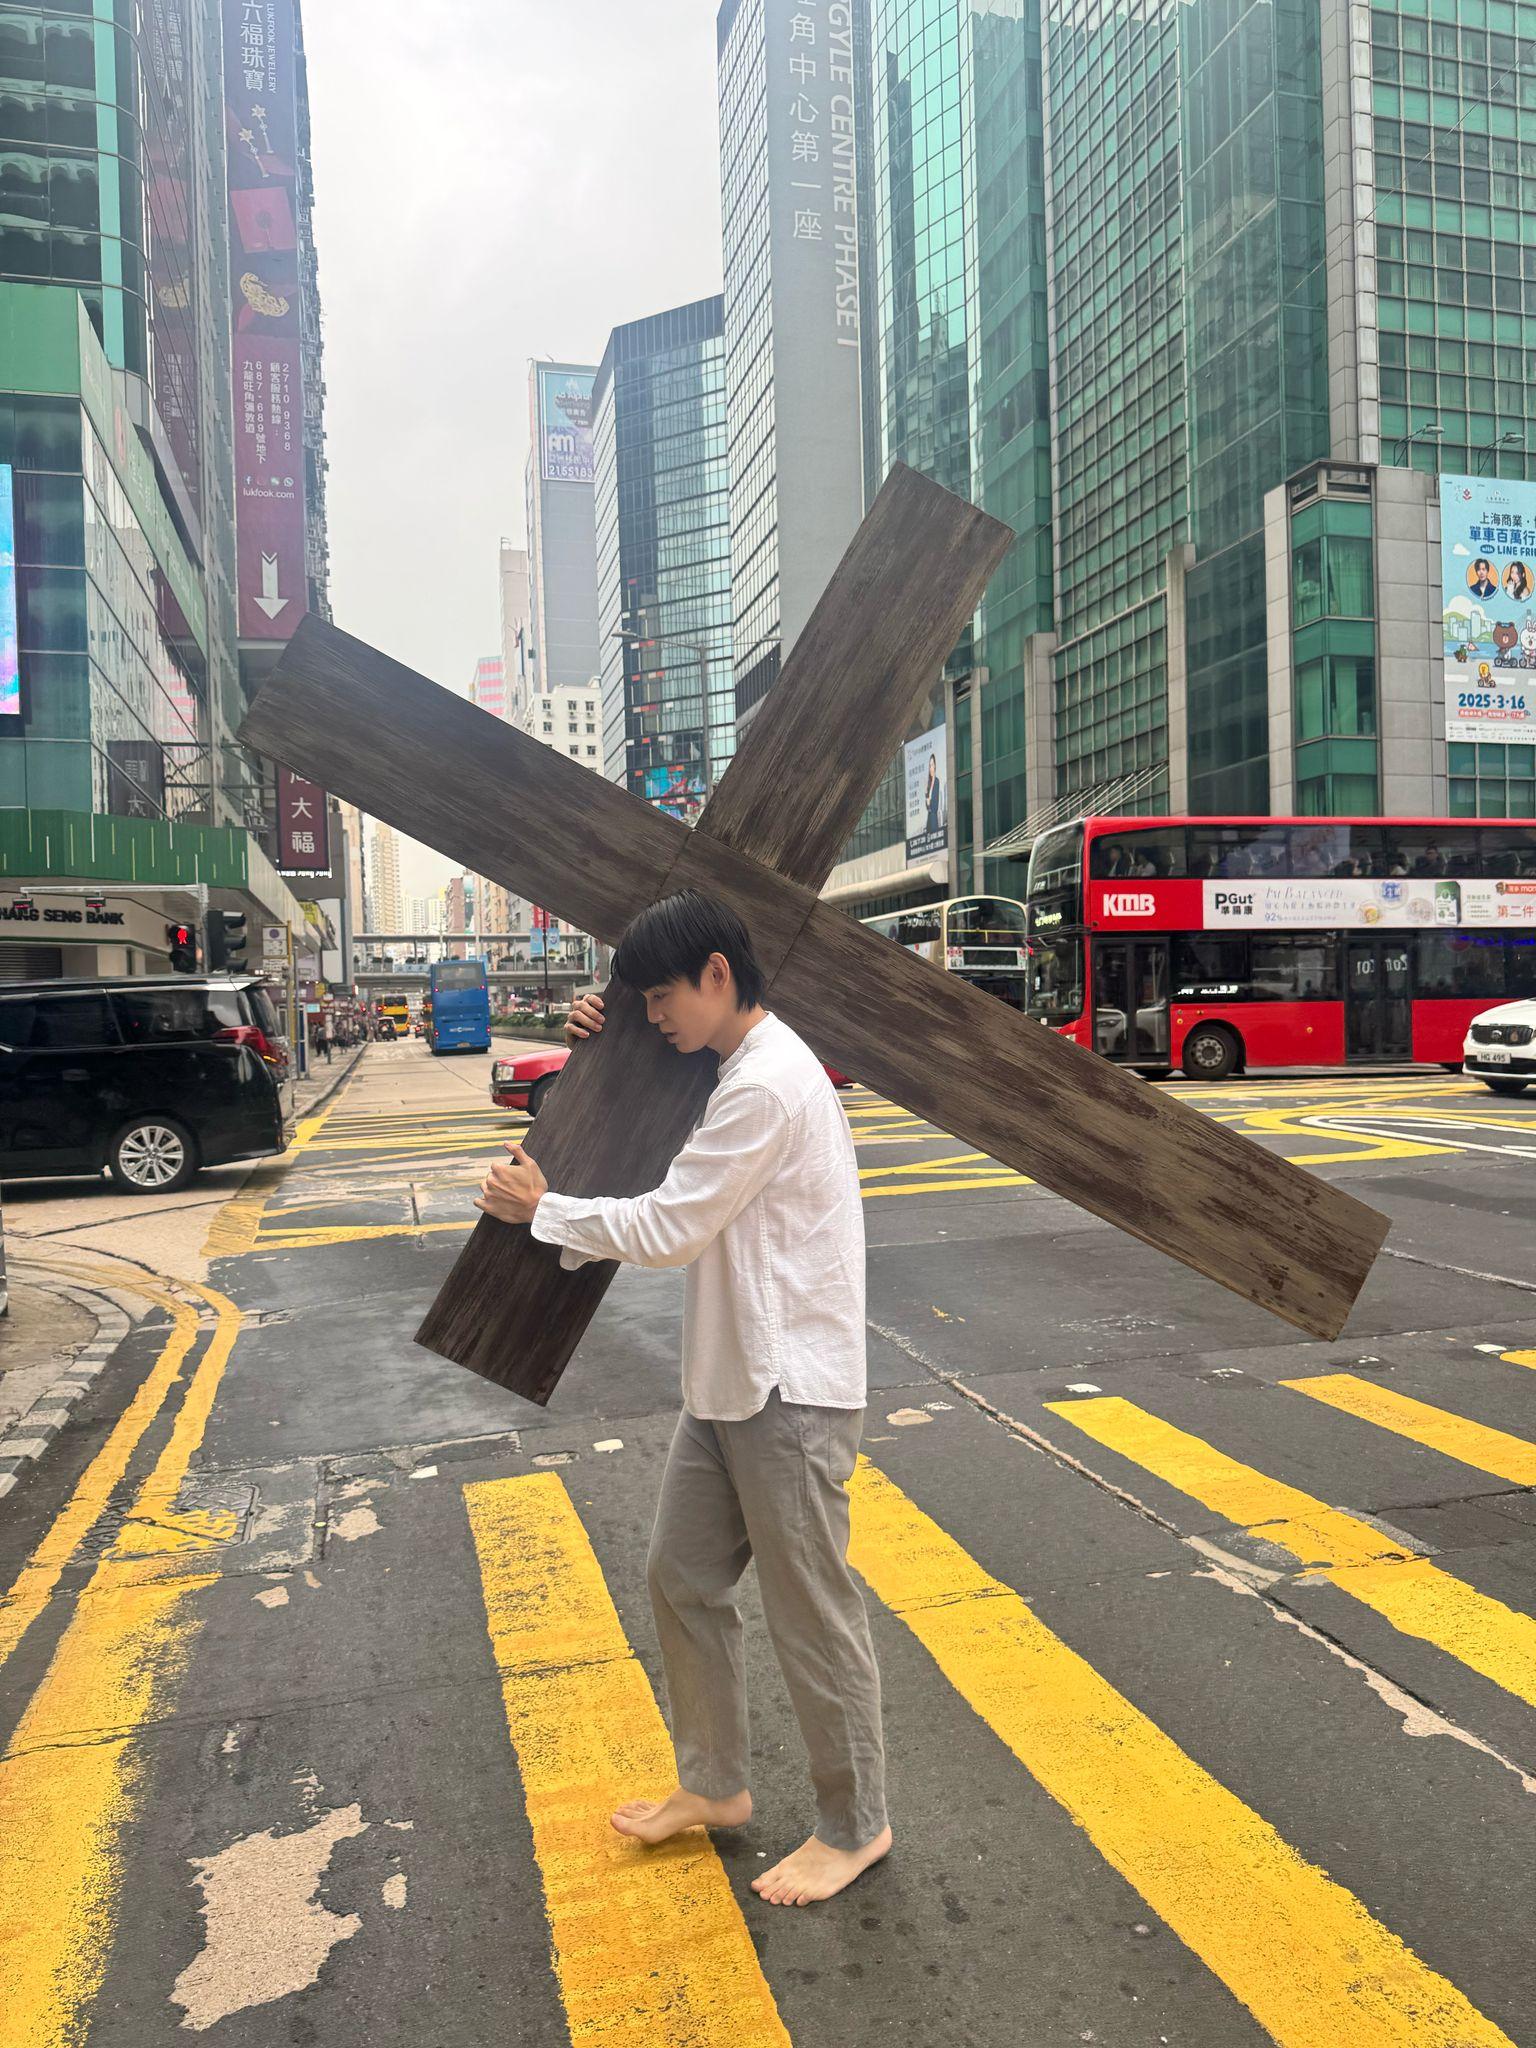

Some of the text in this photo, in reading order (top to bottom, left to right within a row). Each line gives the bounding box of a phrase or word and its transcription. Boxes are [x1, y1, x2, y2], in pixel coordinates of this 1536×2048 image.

[240, 0, 266, 92] 六福珠寶
[266, 3, 278, 94] LUKFOOK JEWELLERY
[828, 0, 852, 83] GYLE
[830, 94, 855, 215] CENTRE
[834, 225, 859, 327] PHASE
[283, 410, 292, 452] 9368
[243, 487, 295, 500] lukfook.com
[1469, 525, 1536, 546] 單車百萬行
[1497, 545, 1518, 556] LINE
[1102, 893, 1156, 917] KMB
[1215, 892, 1254, 910] PGut
[43, 909, 83, 923] SENG
[86, 911, 125, 925] BANK
[1493, 1053, 1506, 1062] 495
